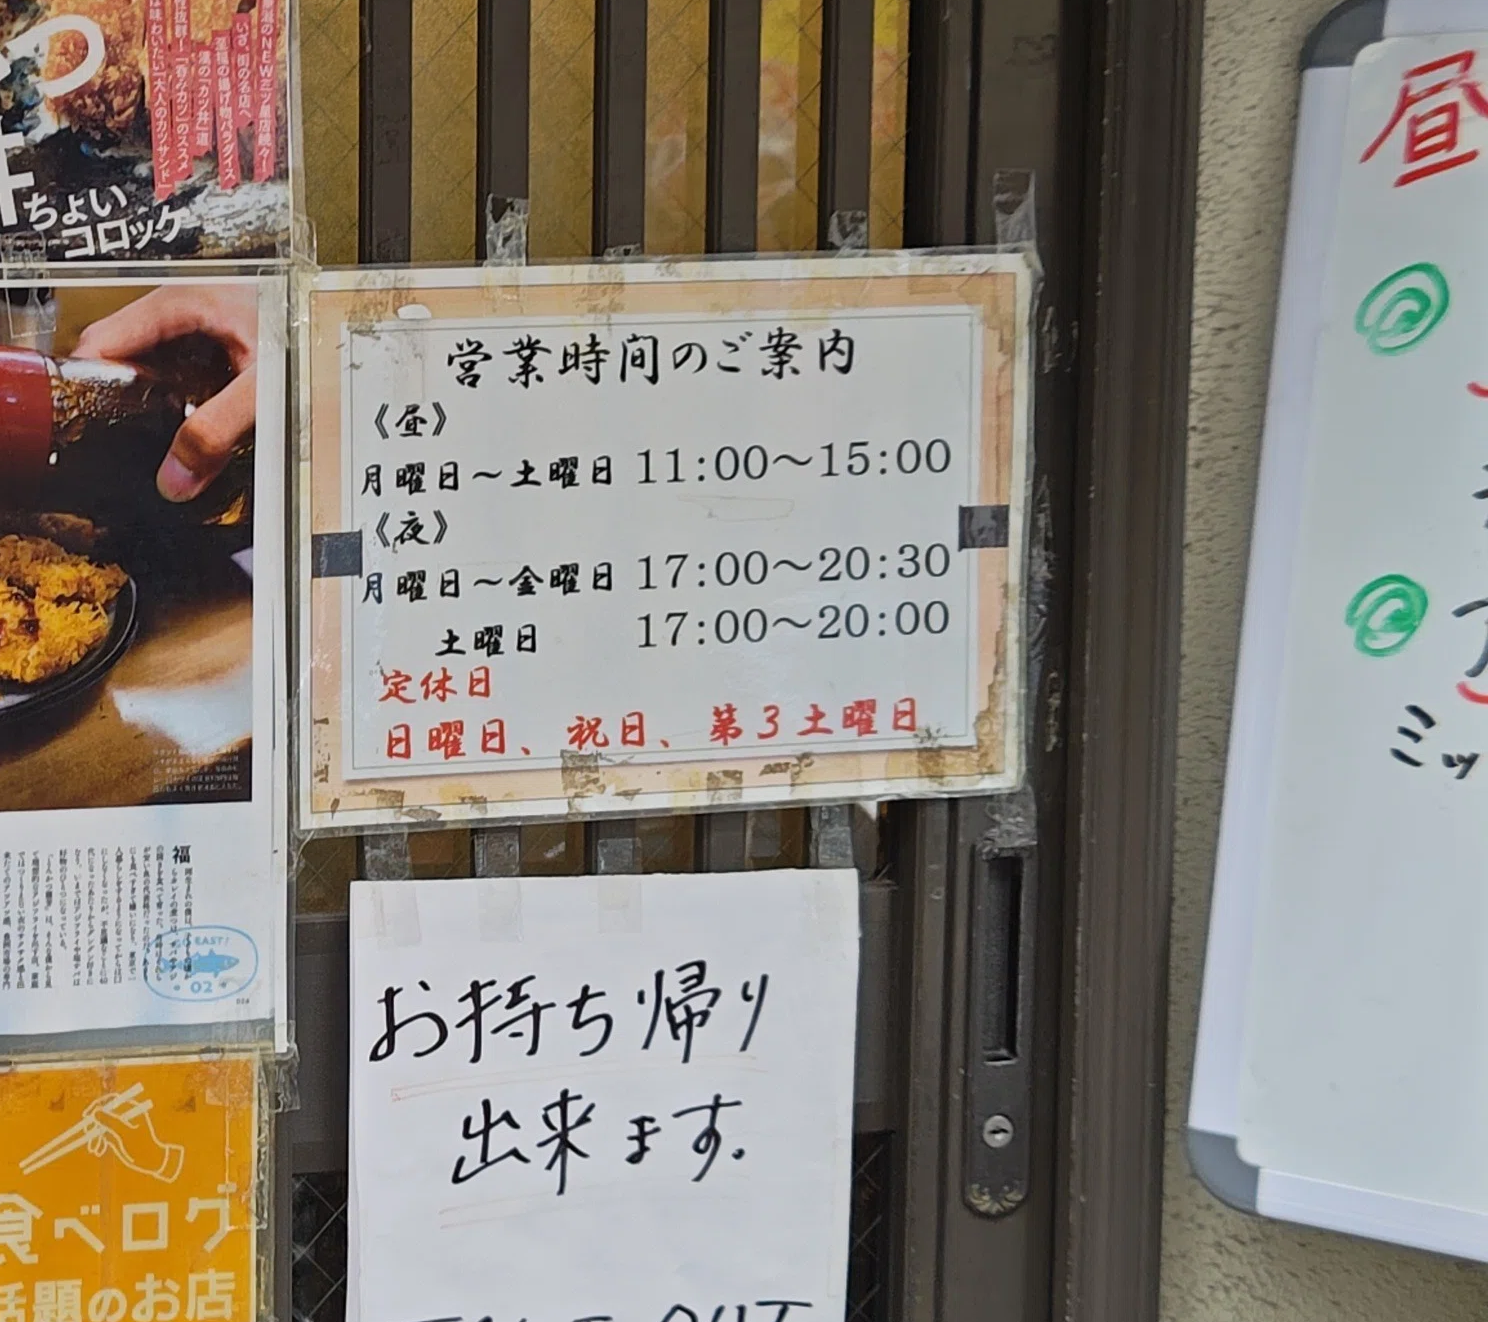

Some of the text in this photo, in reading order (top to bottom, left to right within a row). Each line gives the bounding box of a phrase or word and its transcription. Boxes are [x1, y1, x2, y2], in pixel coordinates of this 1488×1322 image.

[22, 183, 127, 232] ちょい
[63, 204, 201, 260] コロッケ
[445, 327, 857, 391] 営業時間のご案内
[435, 622, 539, 658] 土曜日
[378, 665, 494, 704] 定休日
[190, 980, 213, 993] 02
[367, 959, 770, 1065] お持ち帰り
